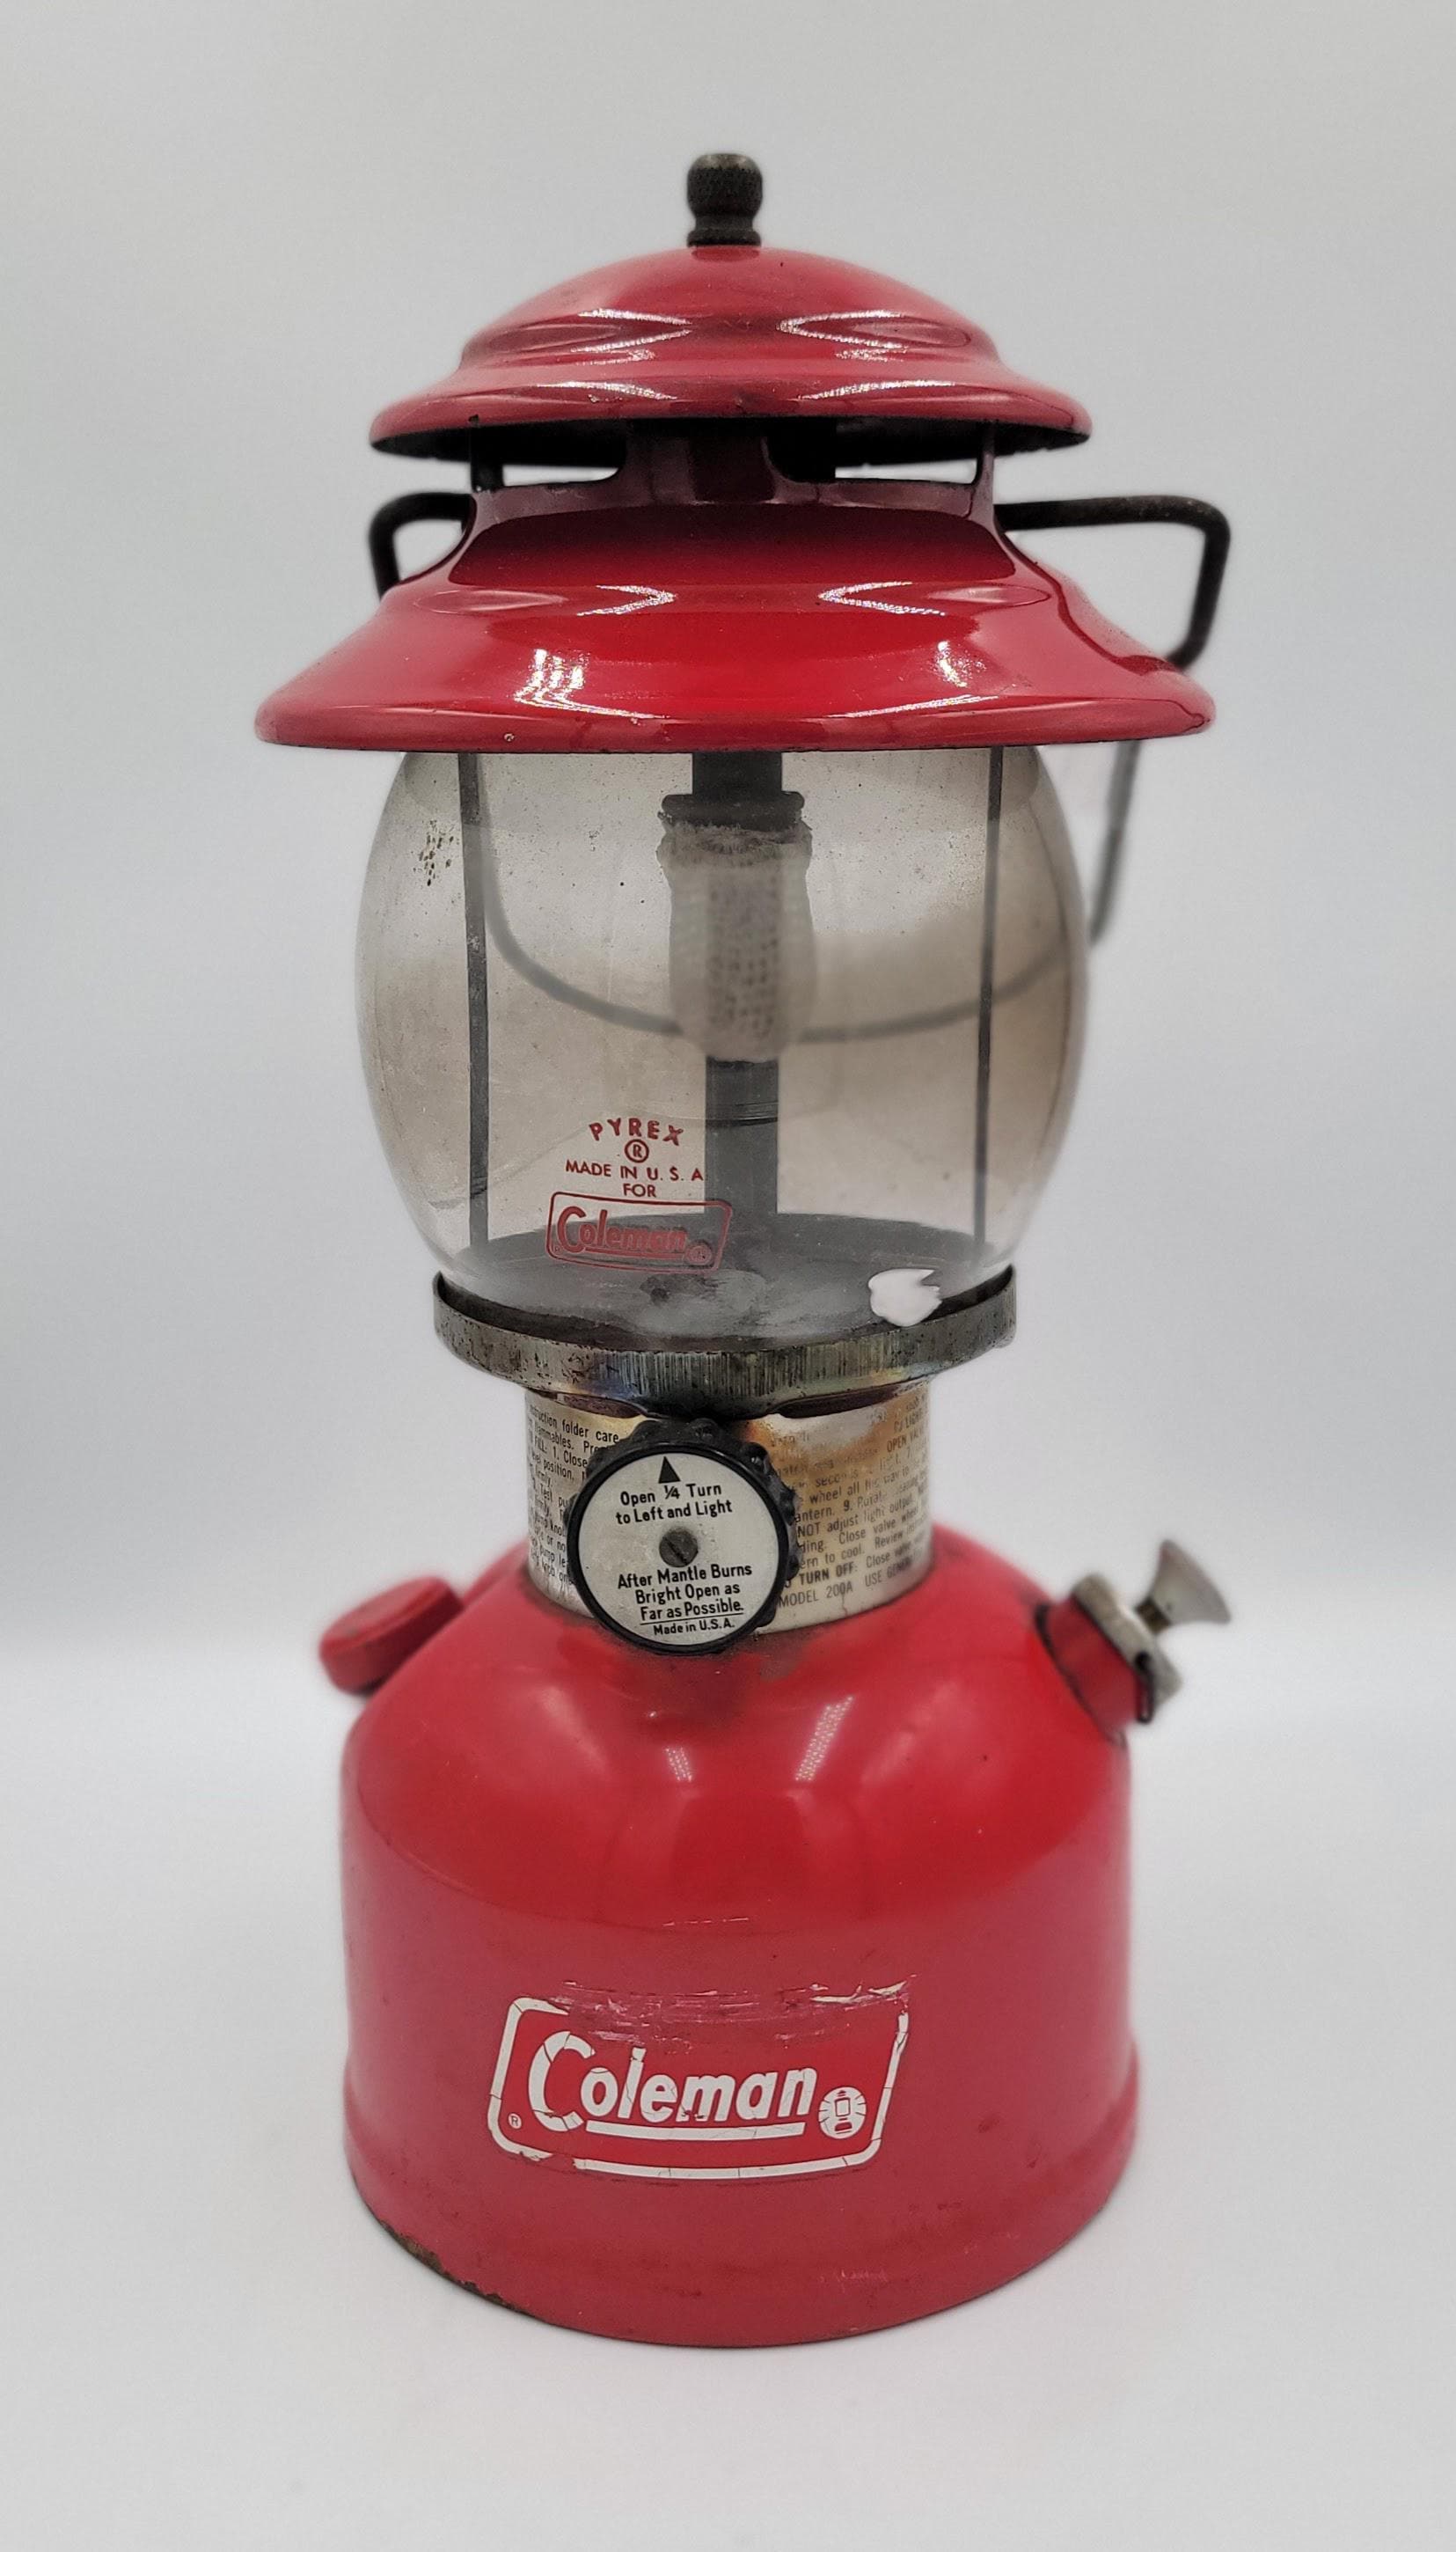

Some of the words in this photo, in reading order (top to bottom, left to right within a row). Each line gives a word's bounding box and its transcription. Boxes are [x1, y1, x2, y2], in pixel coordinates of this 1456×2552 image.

[589, 1118, 684, 1146] PYREX
[565, 1159, 611, 1177] MADE
[620, 1166, 637, 1179] IN
[623, 1184, 656, 1198] FOR
[557, 1206, 687, 1253] Coleman
[562, 1419, 589, 1438] folder
[596, 1431, 619, 1444] care
[887, 1435, 907, 1452] OPEN
[564, 1450, 588, 1468] Close
[620, 1491, 655, 1507] Open
[685, 1483, 721, 1498] Turn
[809, 1485, 842, 1504] wheel
[847, 1482, 860, 1496] all
[616, 1512, 631, 1524] to
[633, 1507, 663, 1522] Left
[667, 1502, 691, 1518] and
[695, 1500, 733, 1517] Light
[794, 1507, 835, 1522] antern.
[797, 1522, 821, 1538] NOT
[827, 1514, 859, 1532] adjust
[838, 1529, 867, 1544] Close
[873, 1519, 896, 1534] valve
[825, 1553, 836, 1564] to
[841, 1544, 865, 1559] cool.
[874, 1531, 904, 1549] Review
[618, 1573, 653, 1589] After
[657, 1566, 706, 1584] Mantle
[711, 1564, 752, 1579] Burns
[799, 1569, 830, 1585] TURN
[866, 1552, 890, 1568] Close
[635, 1586, 681, 1604] Bright
[684, 1583, 720, 1599] Open
[724, 1583, 740, 1595] as
[779, 1589, 819, 1608] MODEL
[826, 1580, 853, 1599] 200A
[865, 1570, 882, 1587] USE
[640, 1606, 662, 1621] Far
[667, 1608, 682, 1618] as
[684, 1597, 744, 1616] Possible.
[654, 1622, 684, 1635] Made
[685, 1621, 696, 1632] in
[699, 1617, 735, 1631] U.S.A.
[529, 2031, 817, 2131] Coleman
